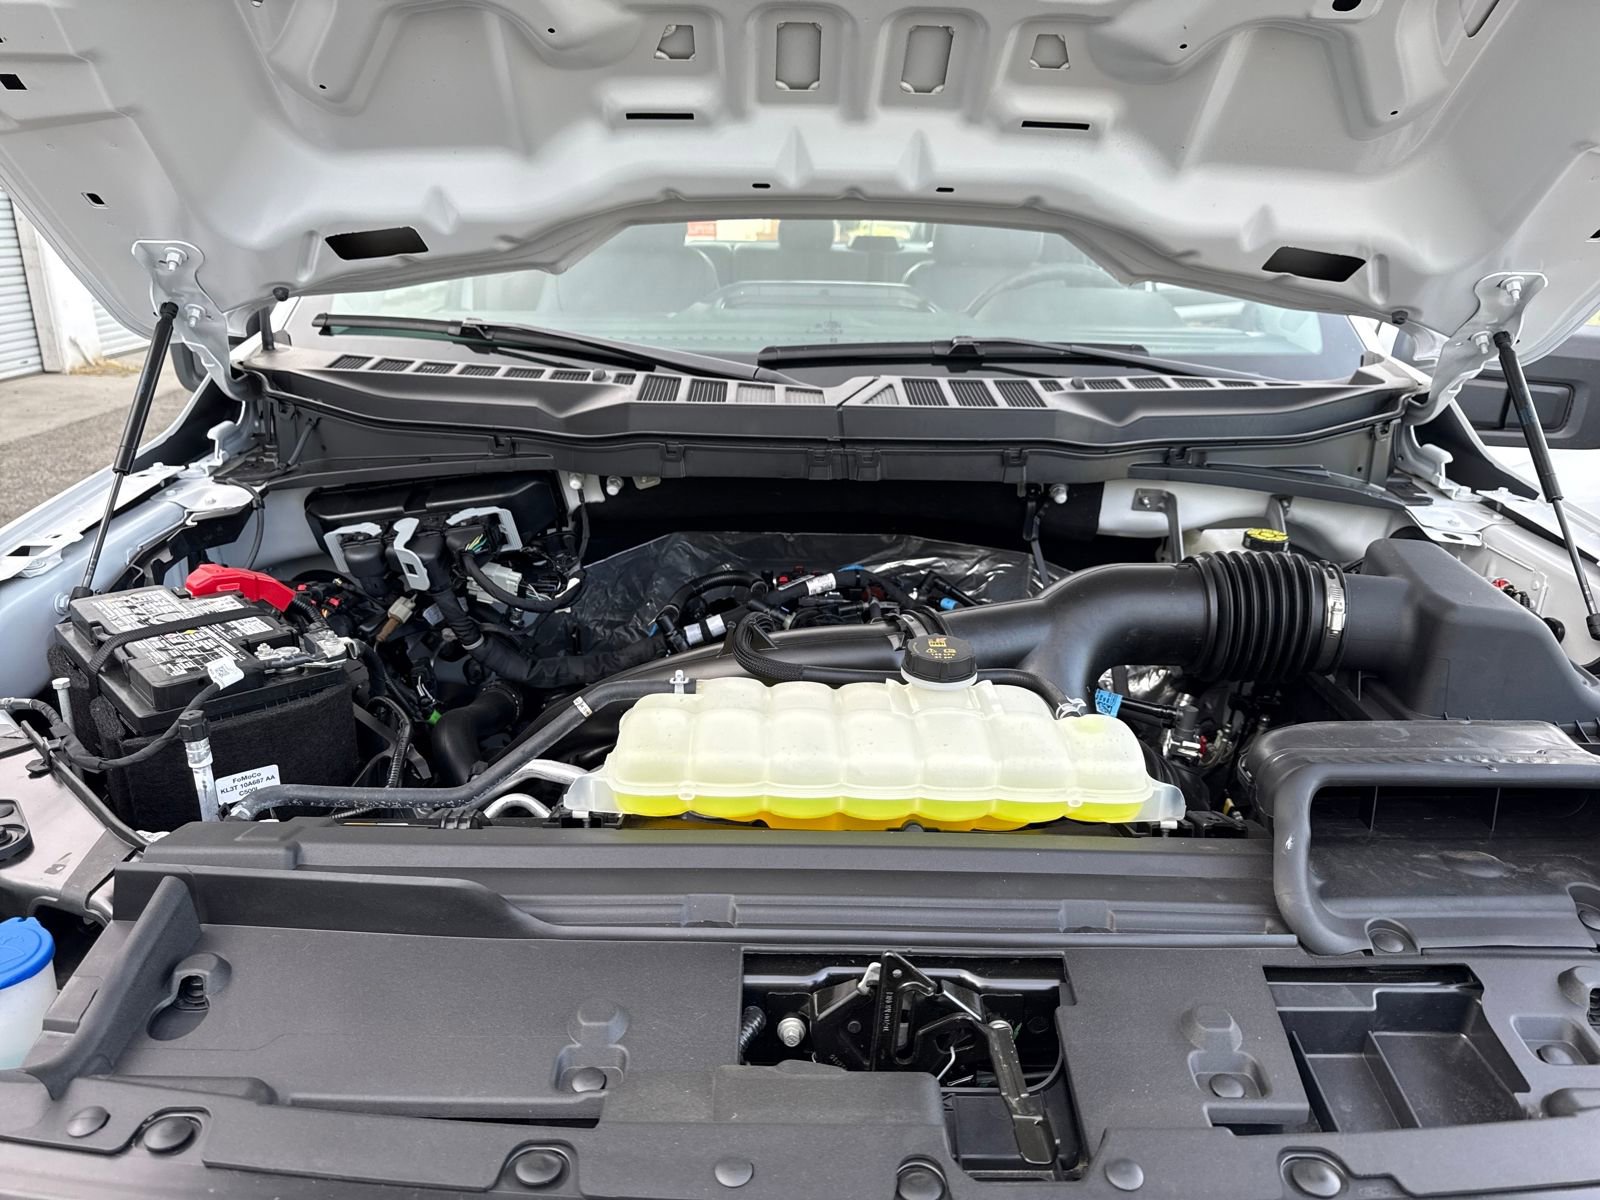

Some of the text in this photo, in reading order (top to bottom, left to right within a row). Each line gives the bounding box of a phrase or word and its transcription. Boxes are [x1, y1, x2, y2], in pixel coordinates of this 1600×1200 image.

[220, 774, 276, 795] KL3T 10A687 AA
[232, 772, 262, 784] FoMoCo
